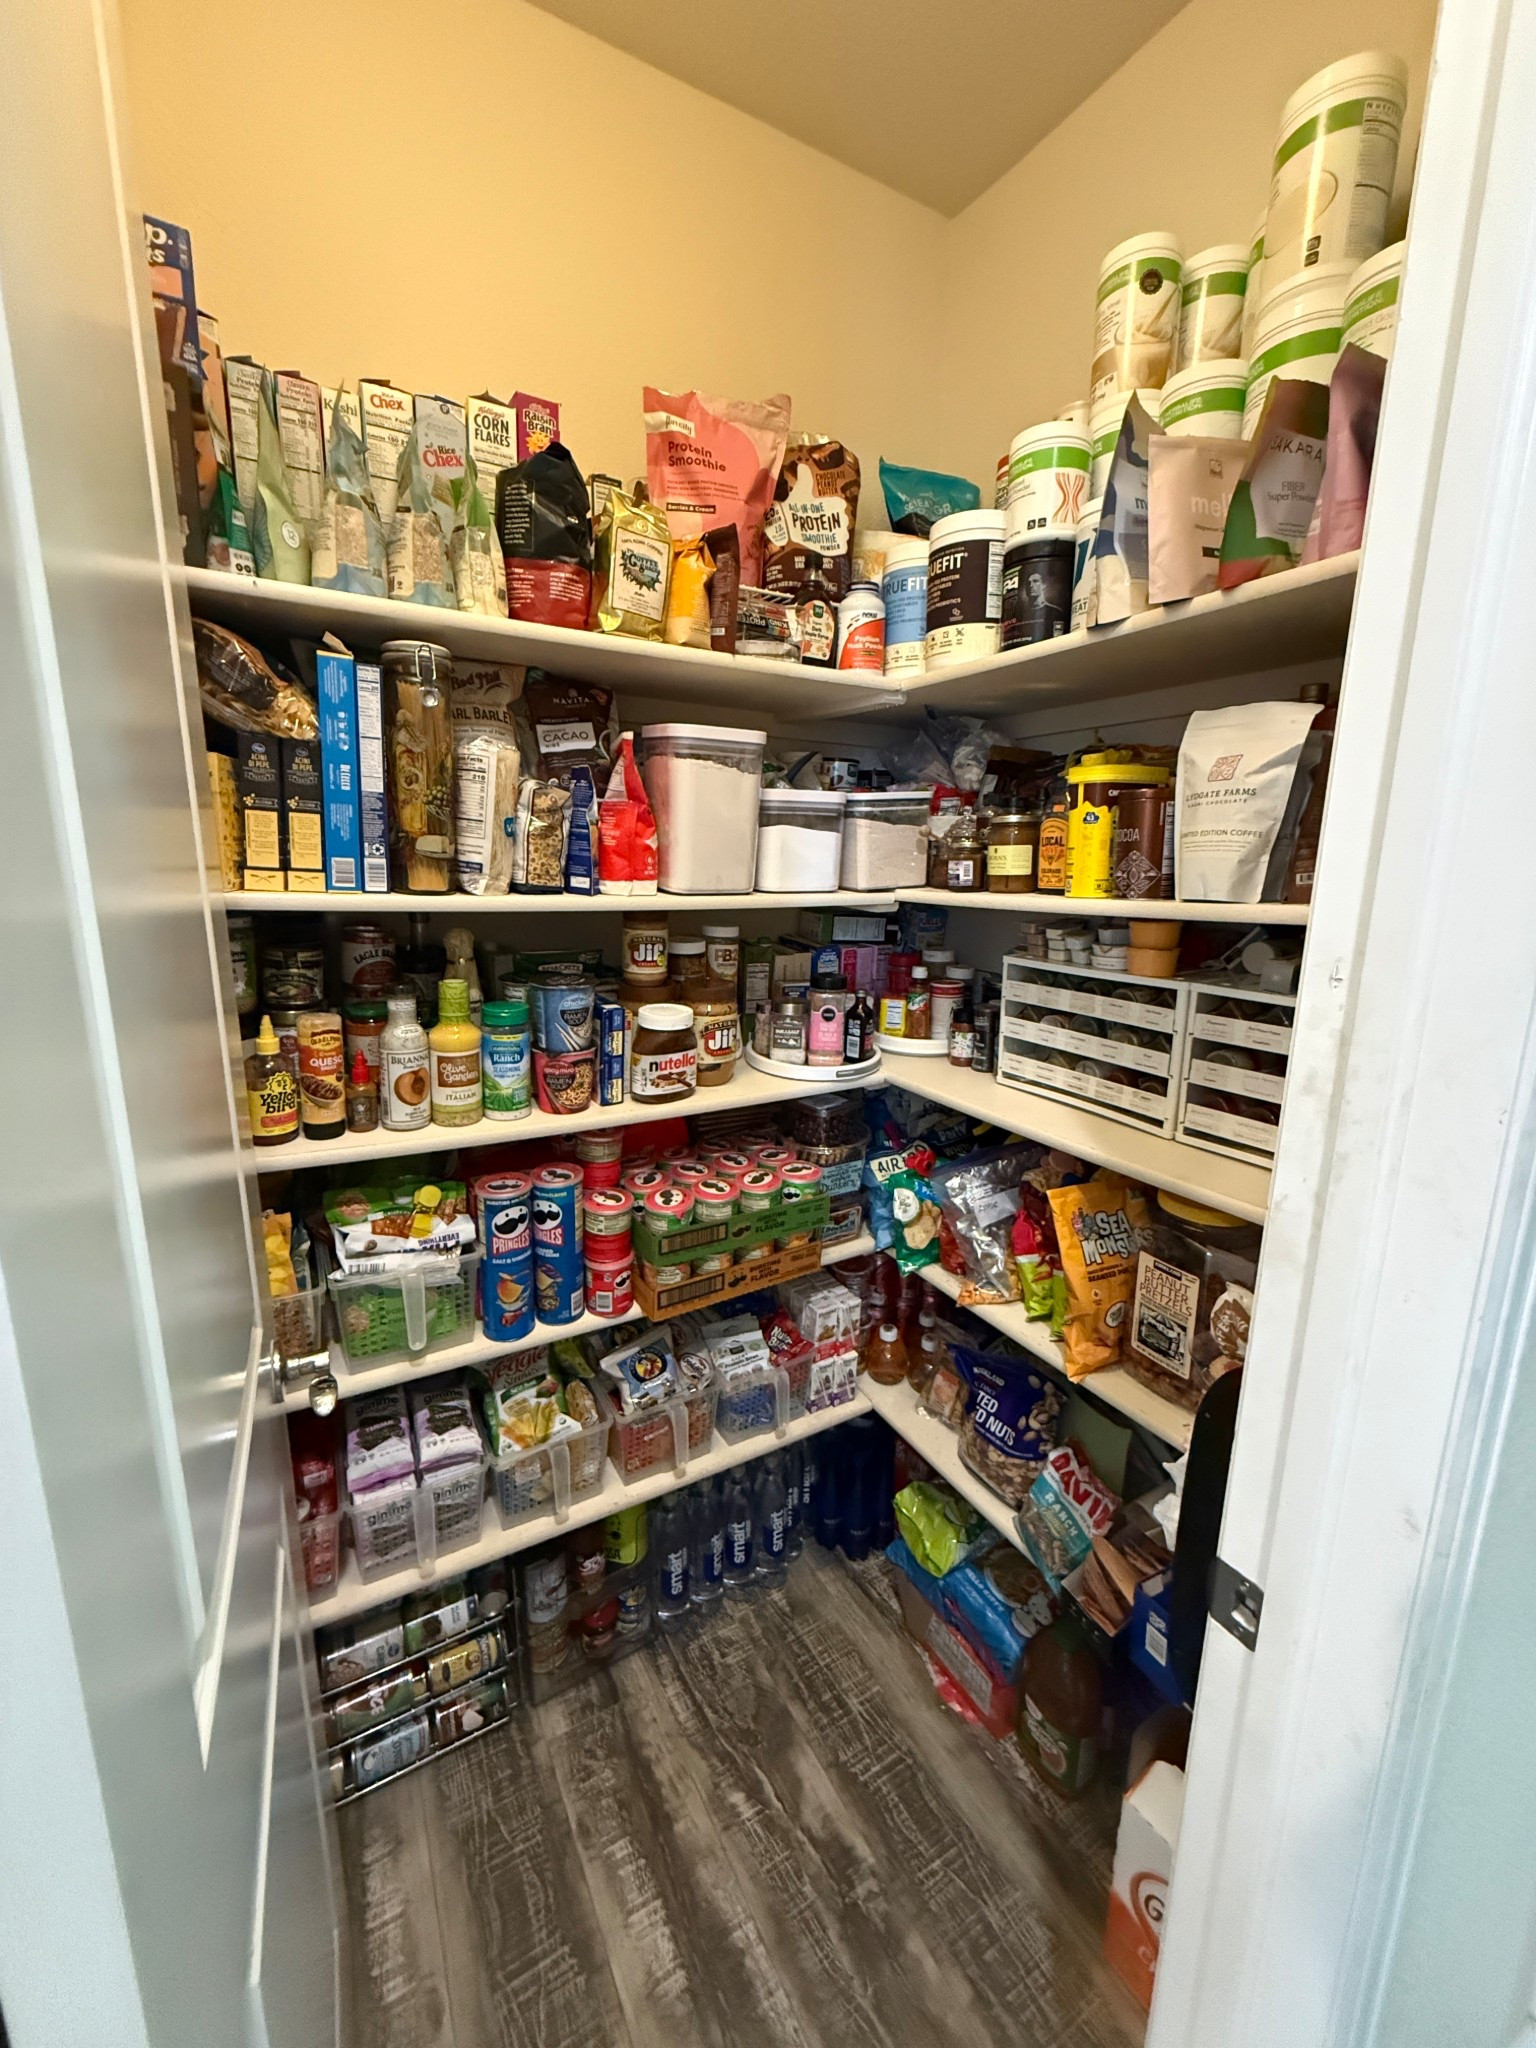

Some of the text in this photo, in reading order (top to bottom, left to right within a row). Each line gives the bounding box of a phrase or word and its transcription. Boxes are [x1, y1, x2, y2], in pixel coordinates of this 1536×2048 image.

[323, 397, 359, 418] Kshi
[370, 395, 404, 412] Chex
[473, 413, 510, 435] CORN
[523, 409, 556, 428] Raisin
[474, 427, 512, 448] FLAKES
[527, 421, 554, 436] Bran
[422, 447, 465, 468] Chex
[437, 444, 457, 456] Rice
[668, 440, 713, 459] Protein
[668, 455, 727, 473] Smoothie
[1267, 490, 1290, 503] Super
[667, 503, 688, 511] Berries
[695, 505, 715, 513] Cream
[791, 511, 842, 533] PROTEIN
[801, 532, 838, 545] SMOOTHIE
[854, 635, 881, 643] Psyllium
[475, 669, 501, 688] Mill
[542, 730, 589, 743] CACAO
[472, 773, 486, 781] 210
[1223, 787, 1257, 797] FARMS
[1041, 835, 1066, 848] LOCAL
[1200, 828, 1264, 839] EDITION COFFEE
[353, 948, 379, 965] EAGLE
[632, 943, 665, 962] Jif
[563, 1011, 588, 1021] RAMEN
[707, 1028, 737, 1051] Jif
[493, 1052, 521, 1063] Ranch
[649, 1053, 697, 1073] nutella
[439, 1062, 467, 1074] Olive
[443, 1070, 480, 1084] Garden
[445, 1092, 478, 1102] ITALIAN
[265, 1099, 296, 1115] bird
[877, 1156, 905, 1174] AIR
[755, 1220, 786, 1233] FLAVOR
[1094, 1209, 1133, 1237] SEA
[418, 1231, 460, 1246] EVERYTHING
[492, 1228, 531, 1256] PRINGLES
[750, 1268, 780, 1282] FLAVOR
[1144, 1264, 1191, 1294] PEANUT
[1143, 1274, 1189, 1306] BUTTER
[1139, 1281, 1193, 1318] PRETZELS
[423, 1388, 464, 1405] gimme
[984, 1414, 1016, 1447] NUTS
[1043, 1491, 1080, 1538] RANCH
[769, 1509, 785, 1553] smart
[731, 1520, 747, 1565] smart
[710, 1533, 724, 1577] smart
[667, 1549, 685, 1596] smart
